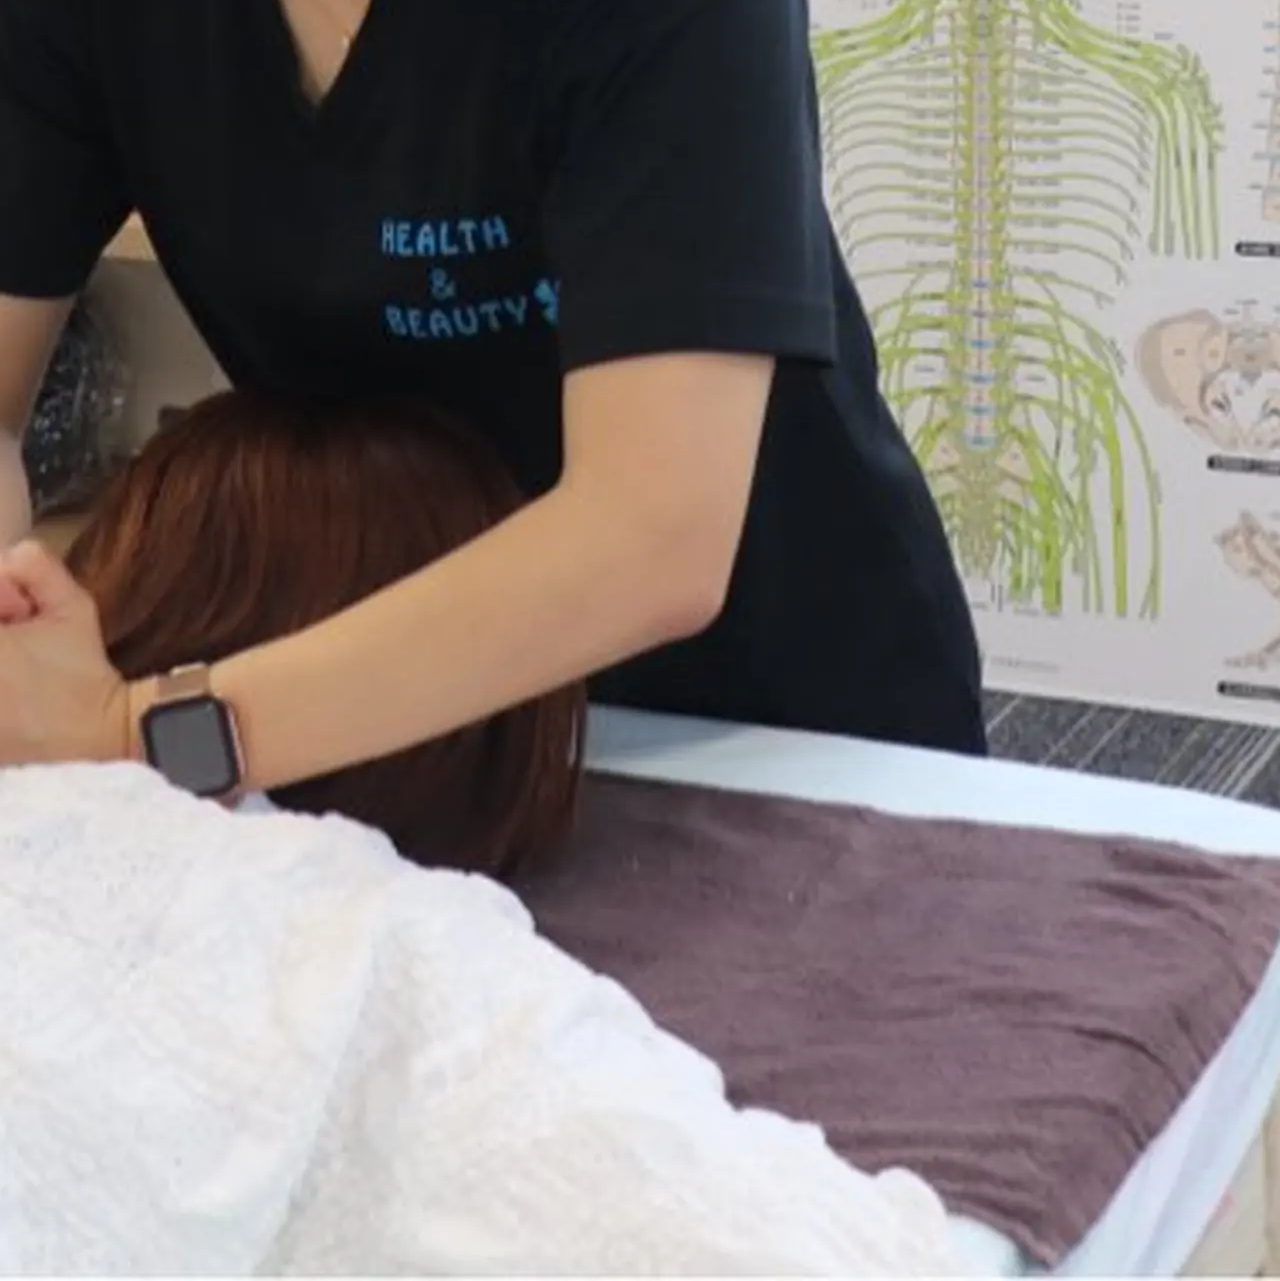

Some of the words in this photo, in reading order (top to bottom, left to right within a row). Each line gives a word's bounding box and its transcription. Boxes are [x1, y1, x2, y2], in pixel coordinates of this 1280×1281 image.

[381, 213, 510, 257] HEALTH
[429, 267, 457, 301] &
[384, 295, 528, 340] BEAUTY
